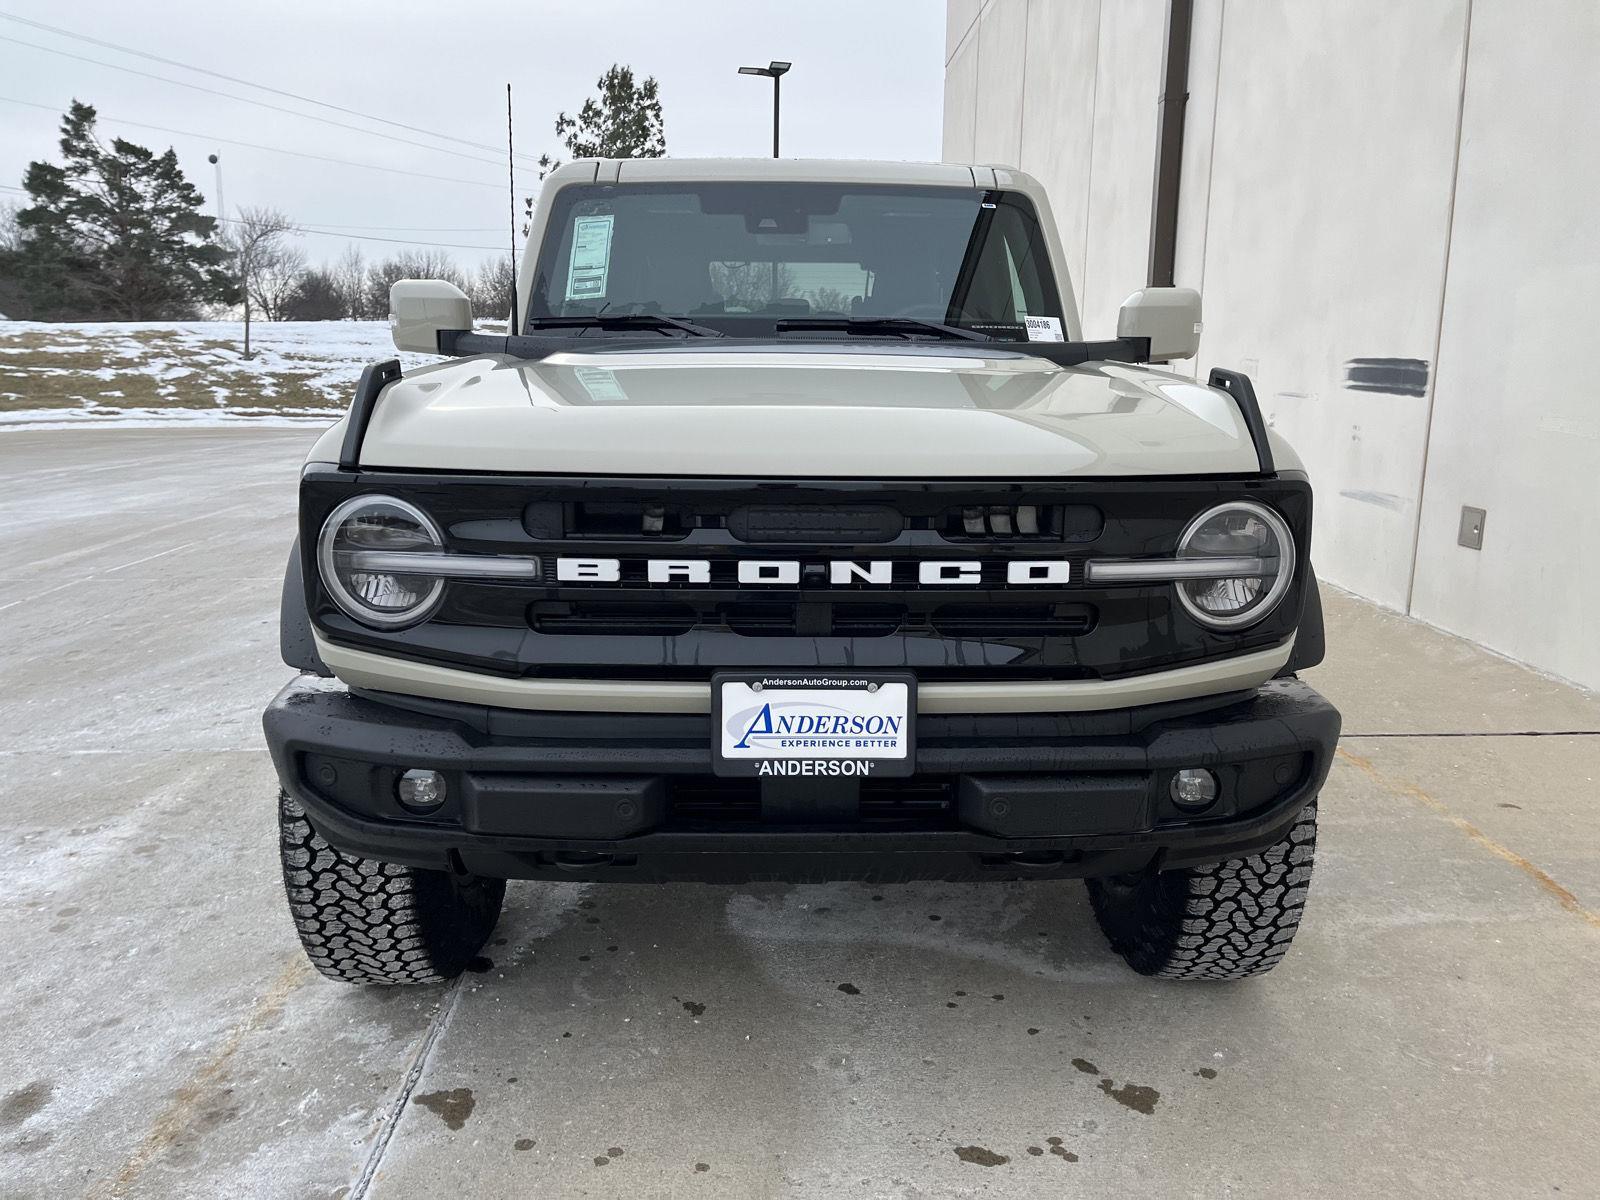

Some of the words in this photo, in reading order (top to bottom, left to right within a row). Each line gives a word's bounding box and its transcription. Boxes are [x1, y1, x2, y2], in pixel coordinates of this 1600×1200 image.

[556, 557, 1071, 586] BRONCO
[762, 678, 868, 687] AndersonAutoGroup.com
[733, 702, 903, 748] ANDERSON
[781, 740, 851, 748] EXPERIENCE
[856, 740, 897, 748] BETTER
[758, 760, 869, 776] ANDERSON
